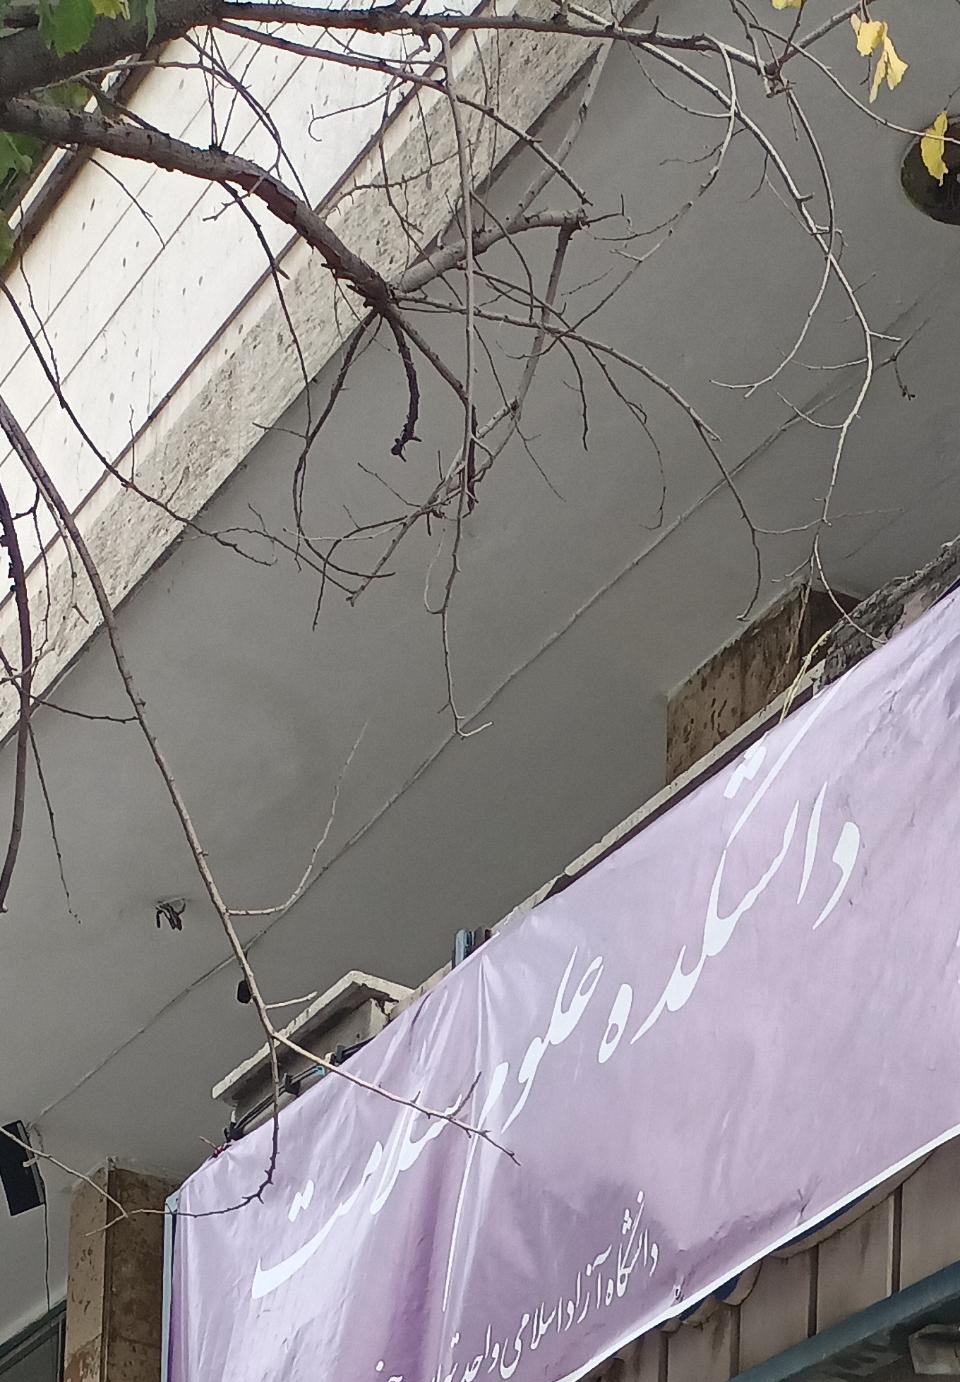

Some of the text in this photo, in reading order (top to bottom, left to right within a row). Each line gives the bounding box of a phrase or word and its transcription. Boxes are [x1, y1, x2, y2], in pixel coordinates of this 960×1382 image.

[251, 672, 861, 1312] دانشکده علوم سلامت
[563, 1244, 612, 1331] آزاد
[605, 1190, 659, 1306] دانشگاه
[499, 1297, 564, 1380] اسلامی
